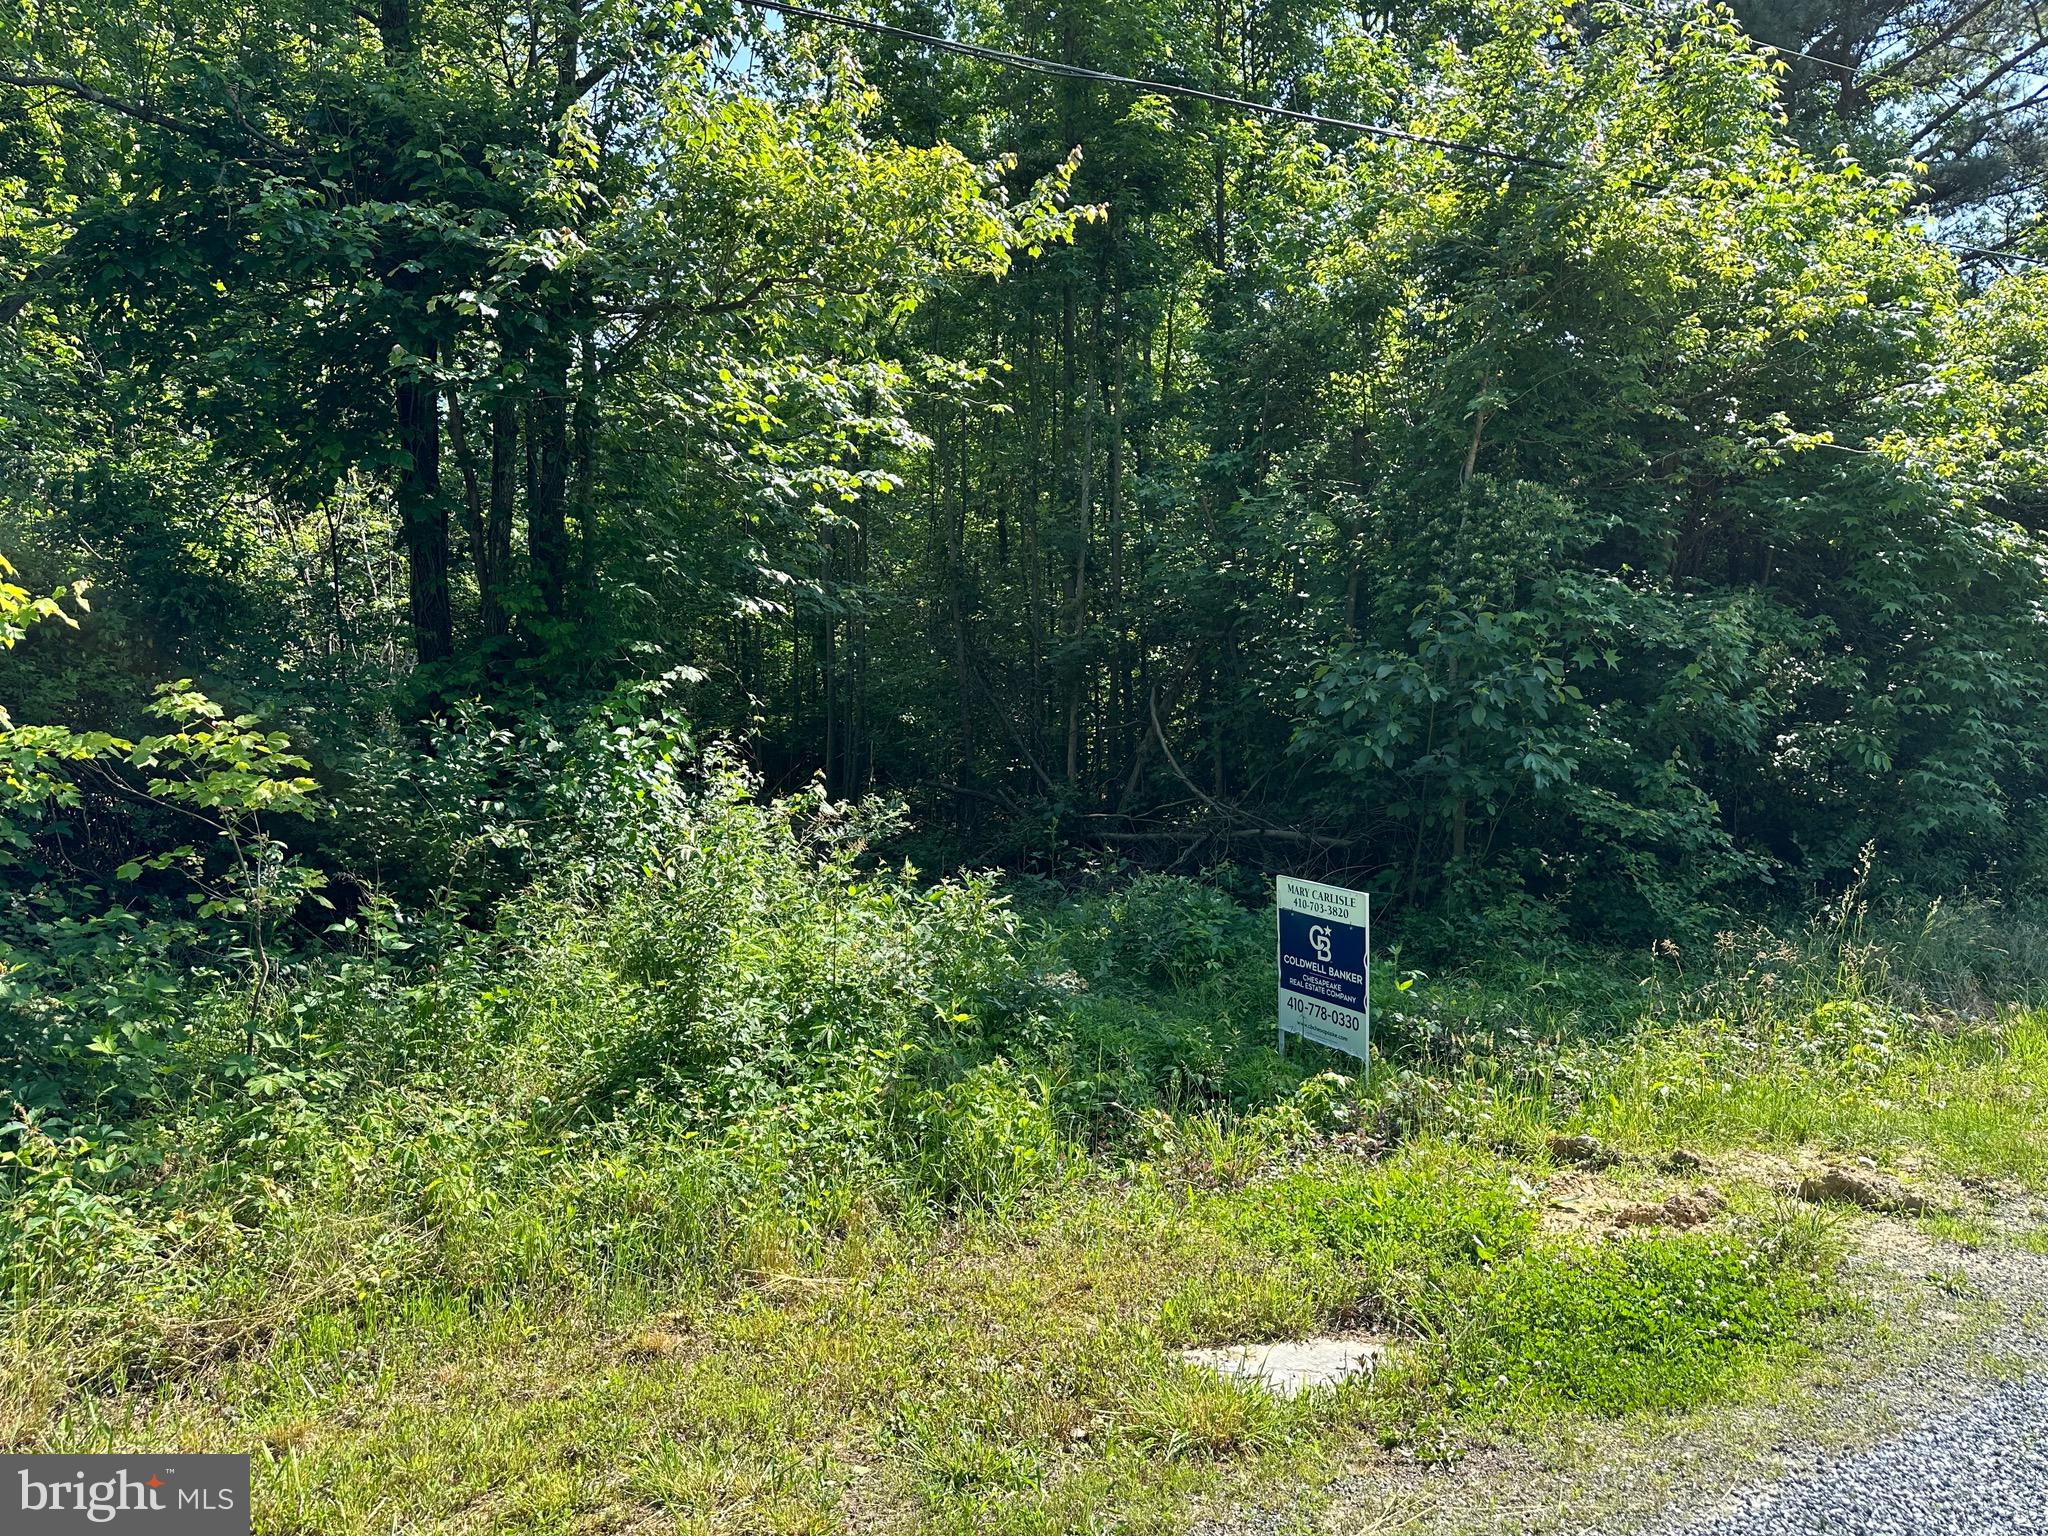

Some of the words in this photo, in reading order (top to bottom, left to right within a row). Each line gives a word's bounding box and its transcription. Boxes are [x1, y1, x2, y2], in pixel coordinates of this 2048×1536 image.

[1287, 884, 1309, 898] MARY
[1312, 890, 1357, 907] CARLISLE
[1294, 898, 1349, 918] 410-703-3820
[1283, 954, 1327, 974] COLDWELL
[1329, 967, 1363, 985] BANKER
[1289, 978, 1304, 988] REAL
[1305, 982, 1325, 995] ESTATE
[1326, 989, 1356, 1003] COMPANY
[1302, 974, 1342, 992] CHESAPEAKE
[1287, 996, 1360, 1031] 410-778-0330
